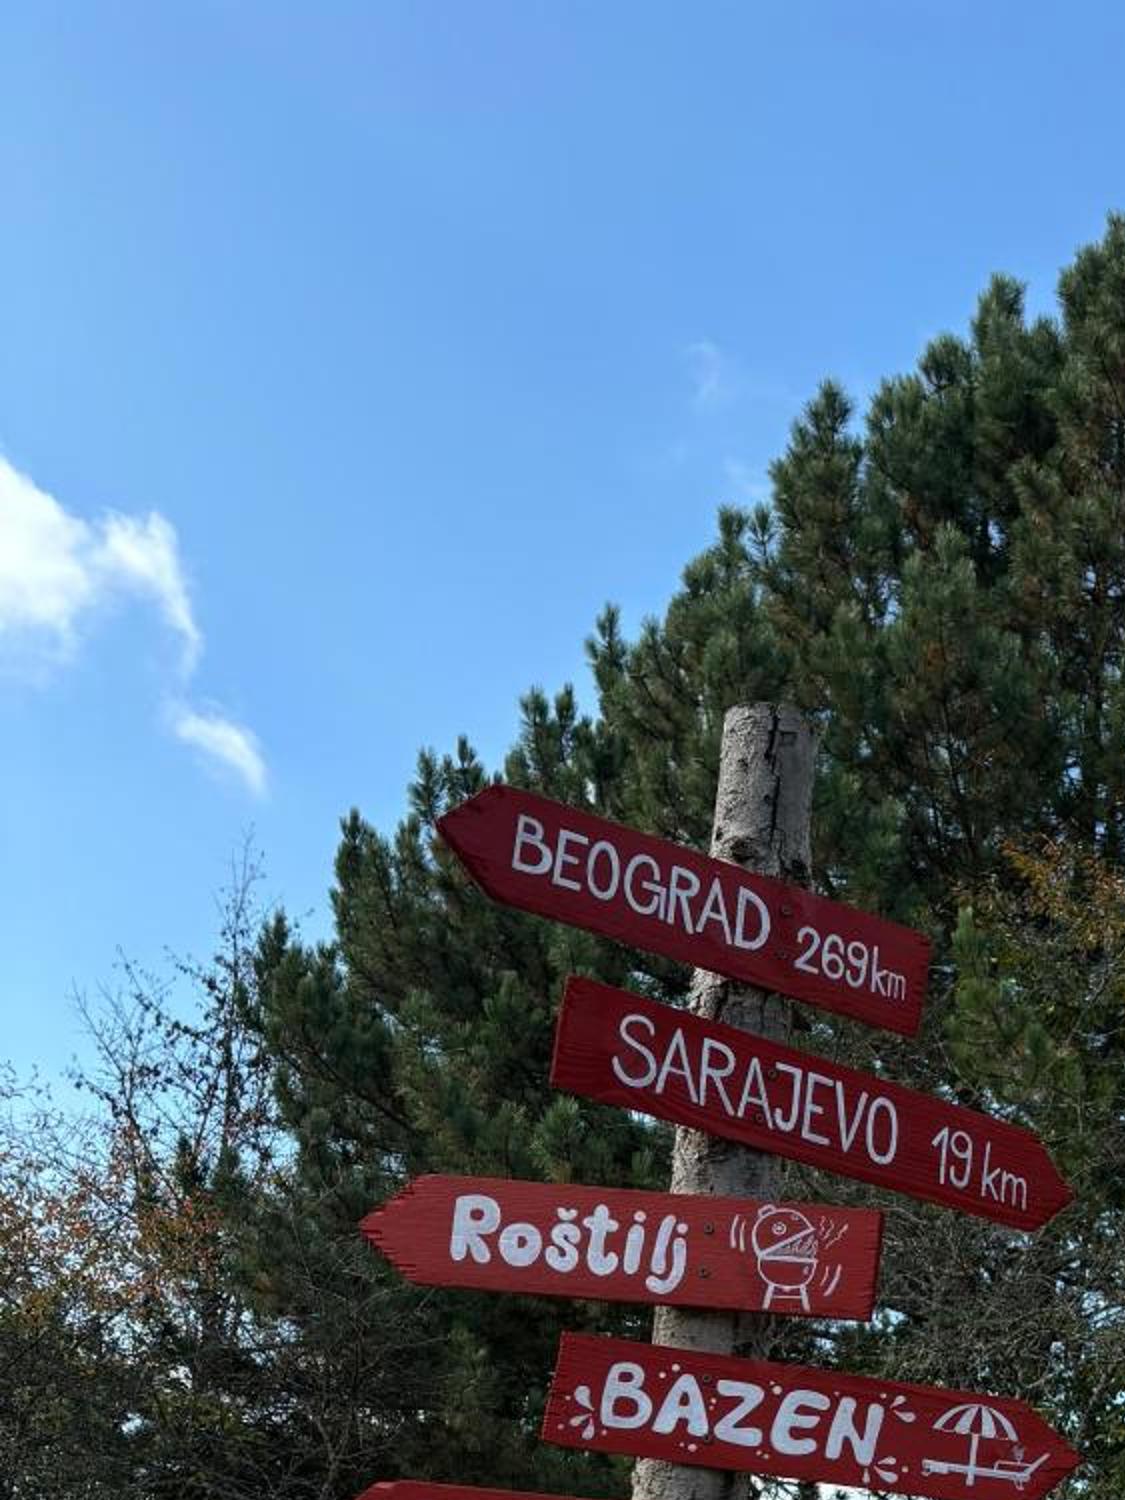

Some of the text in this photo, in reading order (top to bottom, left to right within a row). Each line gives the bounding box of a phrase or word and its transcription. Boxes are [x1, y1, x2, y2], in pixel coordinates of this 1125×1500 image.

[511, 814, 772, 951] BEOGRAD
[611, 1013, 899, 1166] SARAJEVO
[450, 1193, 689, 1295] Roštilj
[600, 1361, 887, 1463] BAZEN
